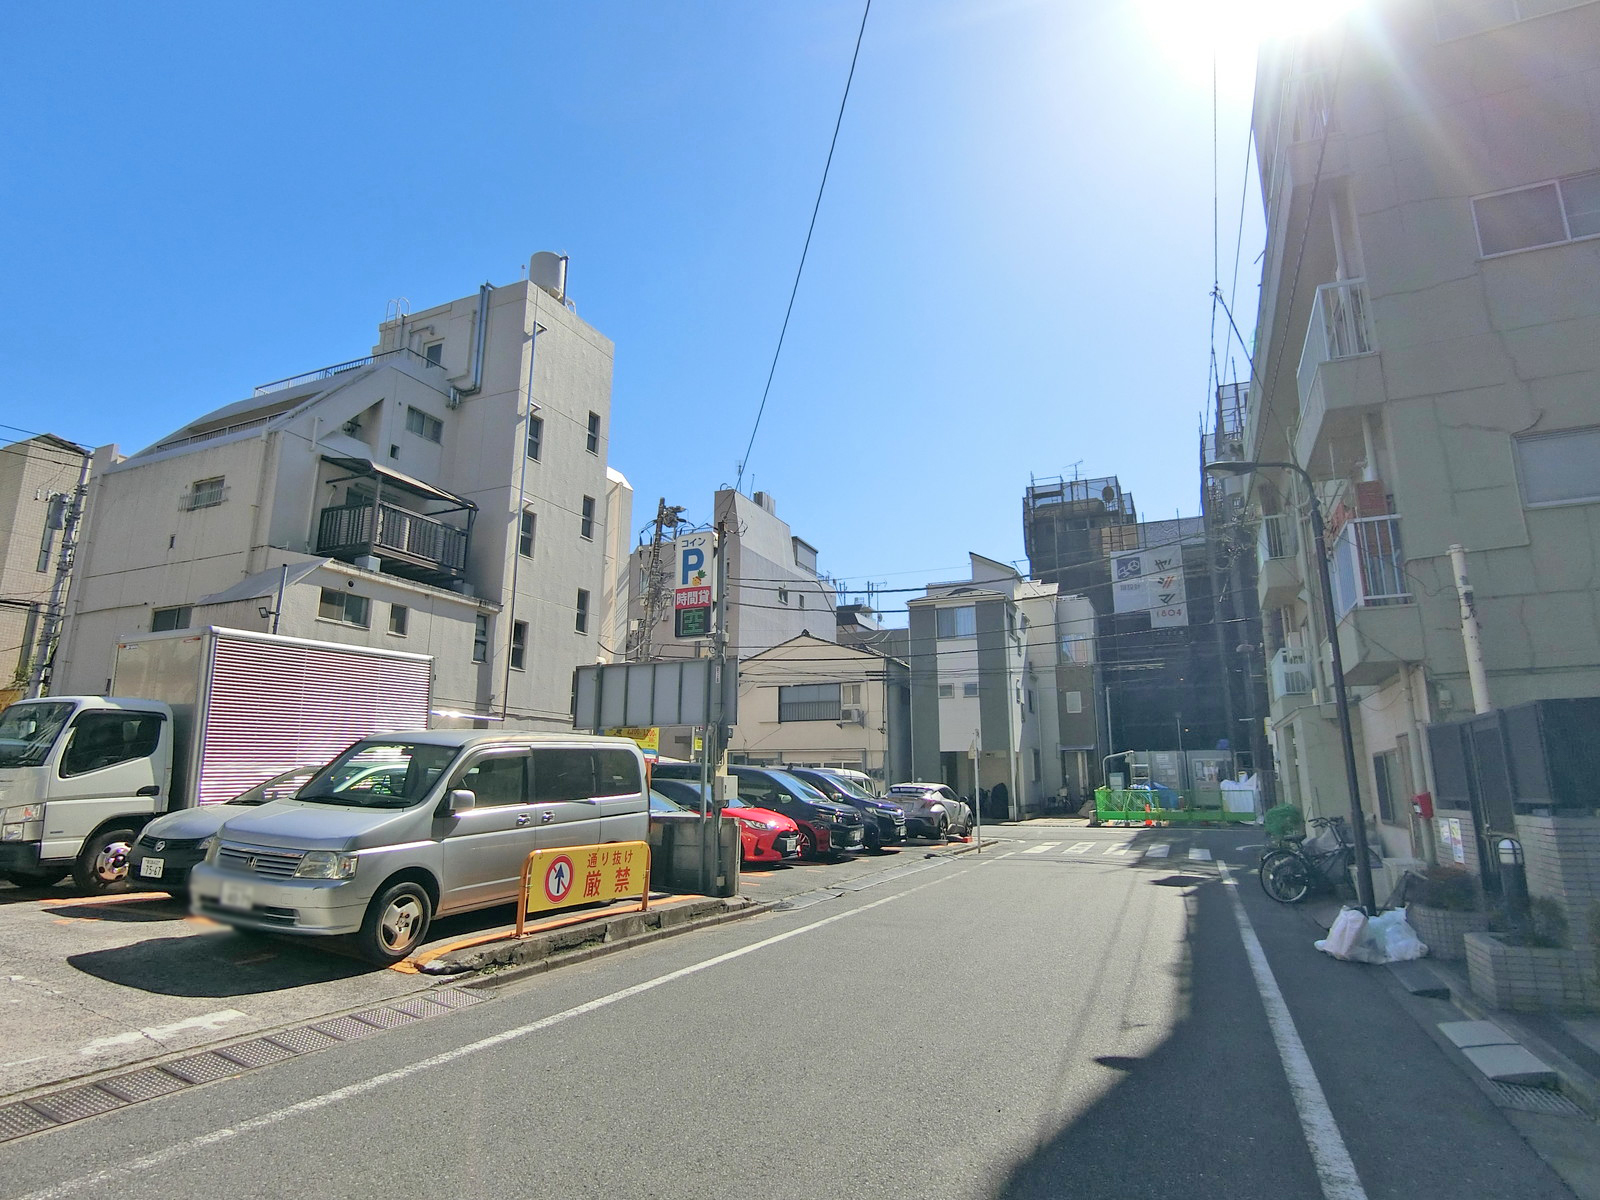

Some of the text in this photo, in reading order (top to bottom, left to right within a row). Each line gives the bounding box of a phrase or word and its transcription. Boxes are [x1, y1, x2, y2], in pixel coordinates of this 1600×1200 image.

[681, 537, 706, 548] コイン
[682, 548, 704, 585] P
[676, 589, 710, 606] 時間貸
[1156, 608, 1182, 617] 1804
[587, 850, 634, 868] 通り抜け
[145, 864, 162, 877] 75-67
[583, 866, 631, 898] 厳禁
